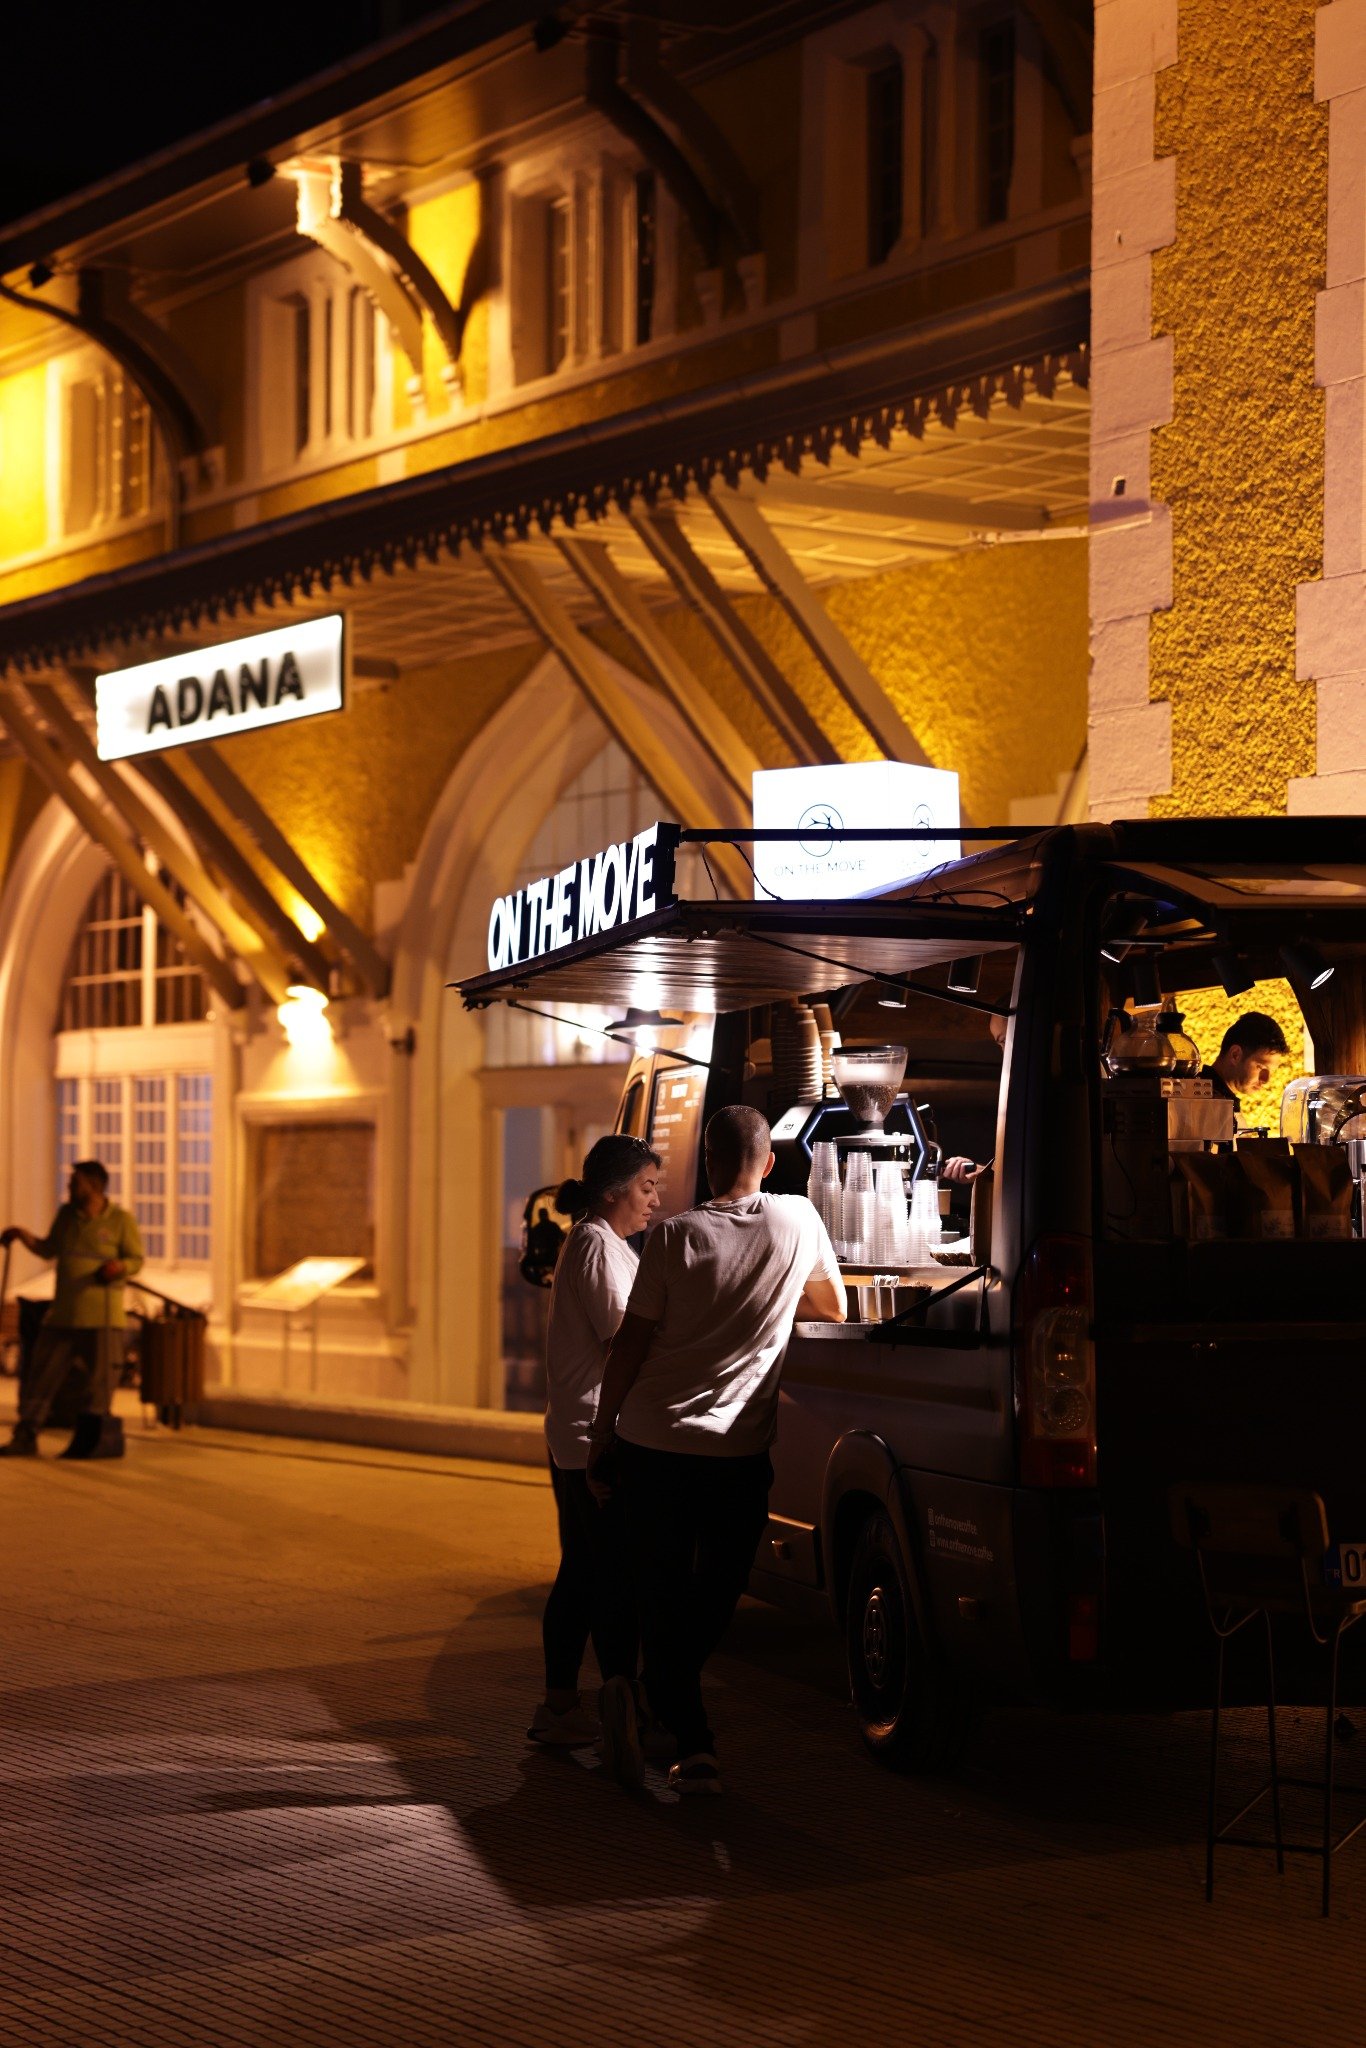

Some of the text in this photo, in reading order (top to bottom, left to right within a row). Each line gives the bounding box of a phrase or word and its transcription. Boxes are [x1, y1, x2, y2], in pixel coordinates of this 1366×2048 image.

[146, 651, 305, 735] ADANA
[487, 821, 659, 971] ON THE MOVE
[774, 859, 866, 877] ON THE MOVE
